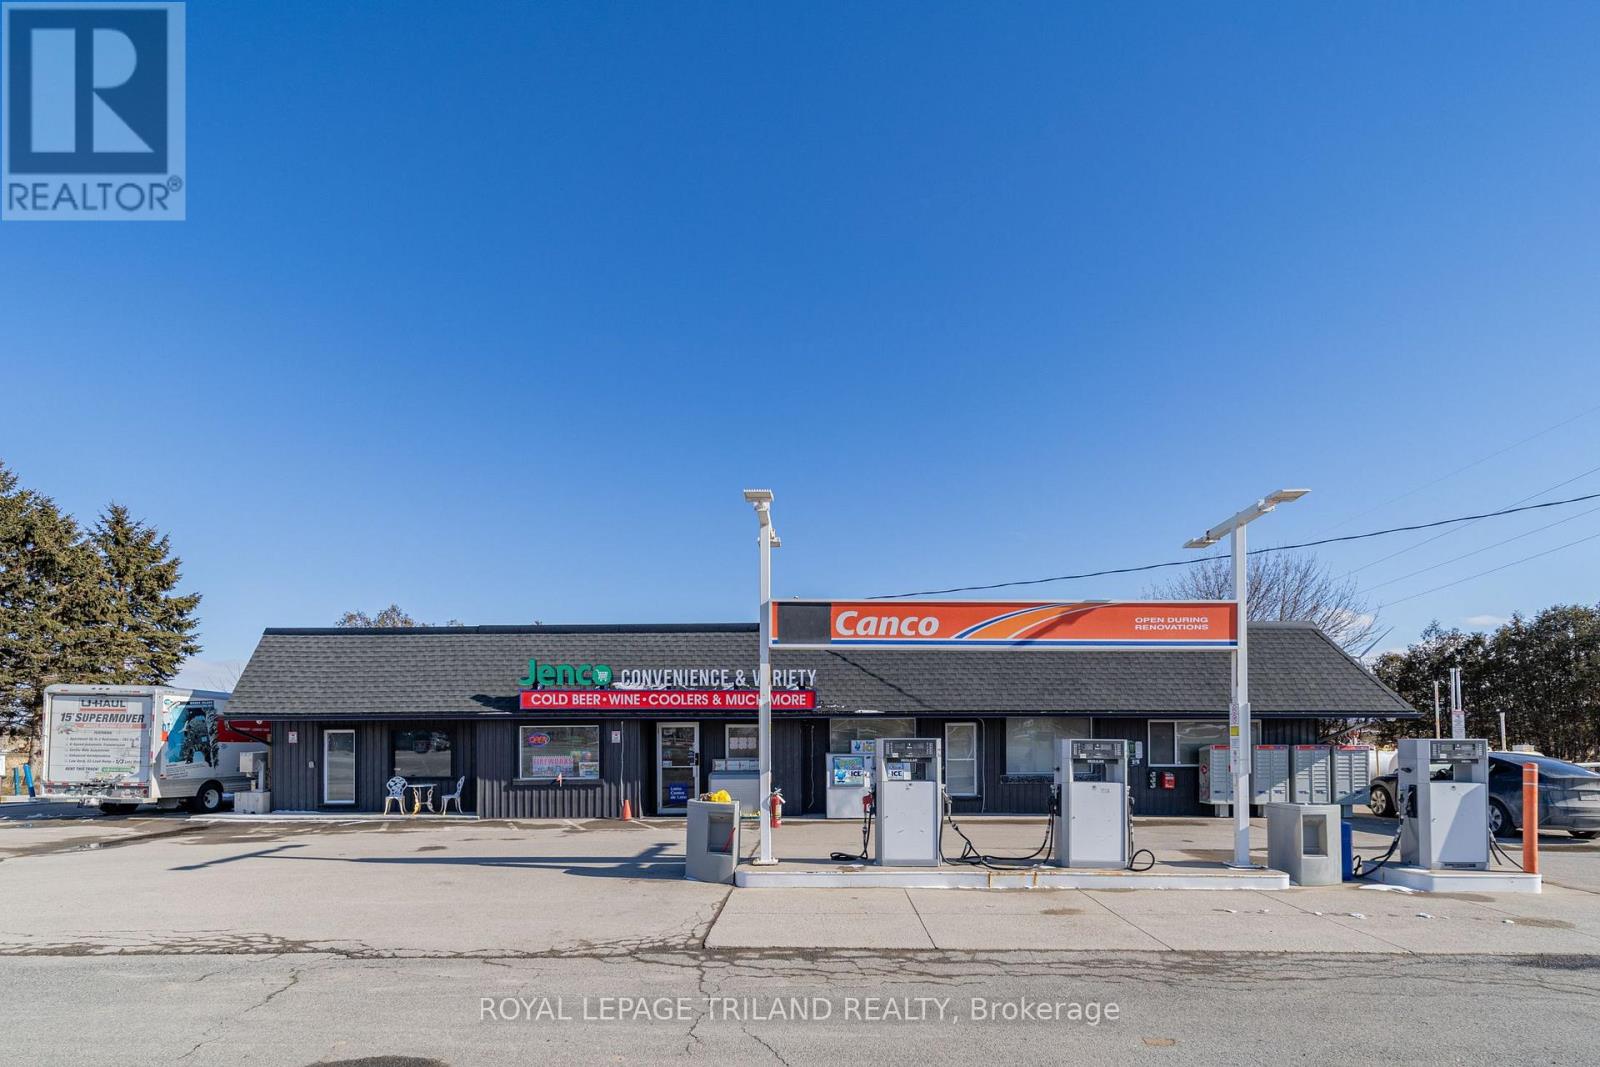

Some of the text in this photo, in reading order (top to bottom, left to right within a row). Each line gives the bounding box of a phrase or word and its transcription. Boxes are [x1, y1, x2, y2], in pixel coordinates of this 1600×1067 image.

[835, 611, 940, 636] Canco
[519, 658, 612, 686] Jenco
[621, 669, 817, 687] CONVENIENCE & VRIETY
[81, 699, 126, 708] U-HAUL
[531, 694, 568, 705] COLD
[571, 694, 601, 705] BEER
[608, 694, 640, 705] WINE
[648, 694, 709, 706] COOLERS
[712, 694, 721, 705] &
[770, 694, 806, 705] MORE
[75, 713, 145, 723] SUPERMOVER
